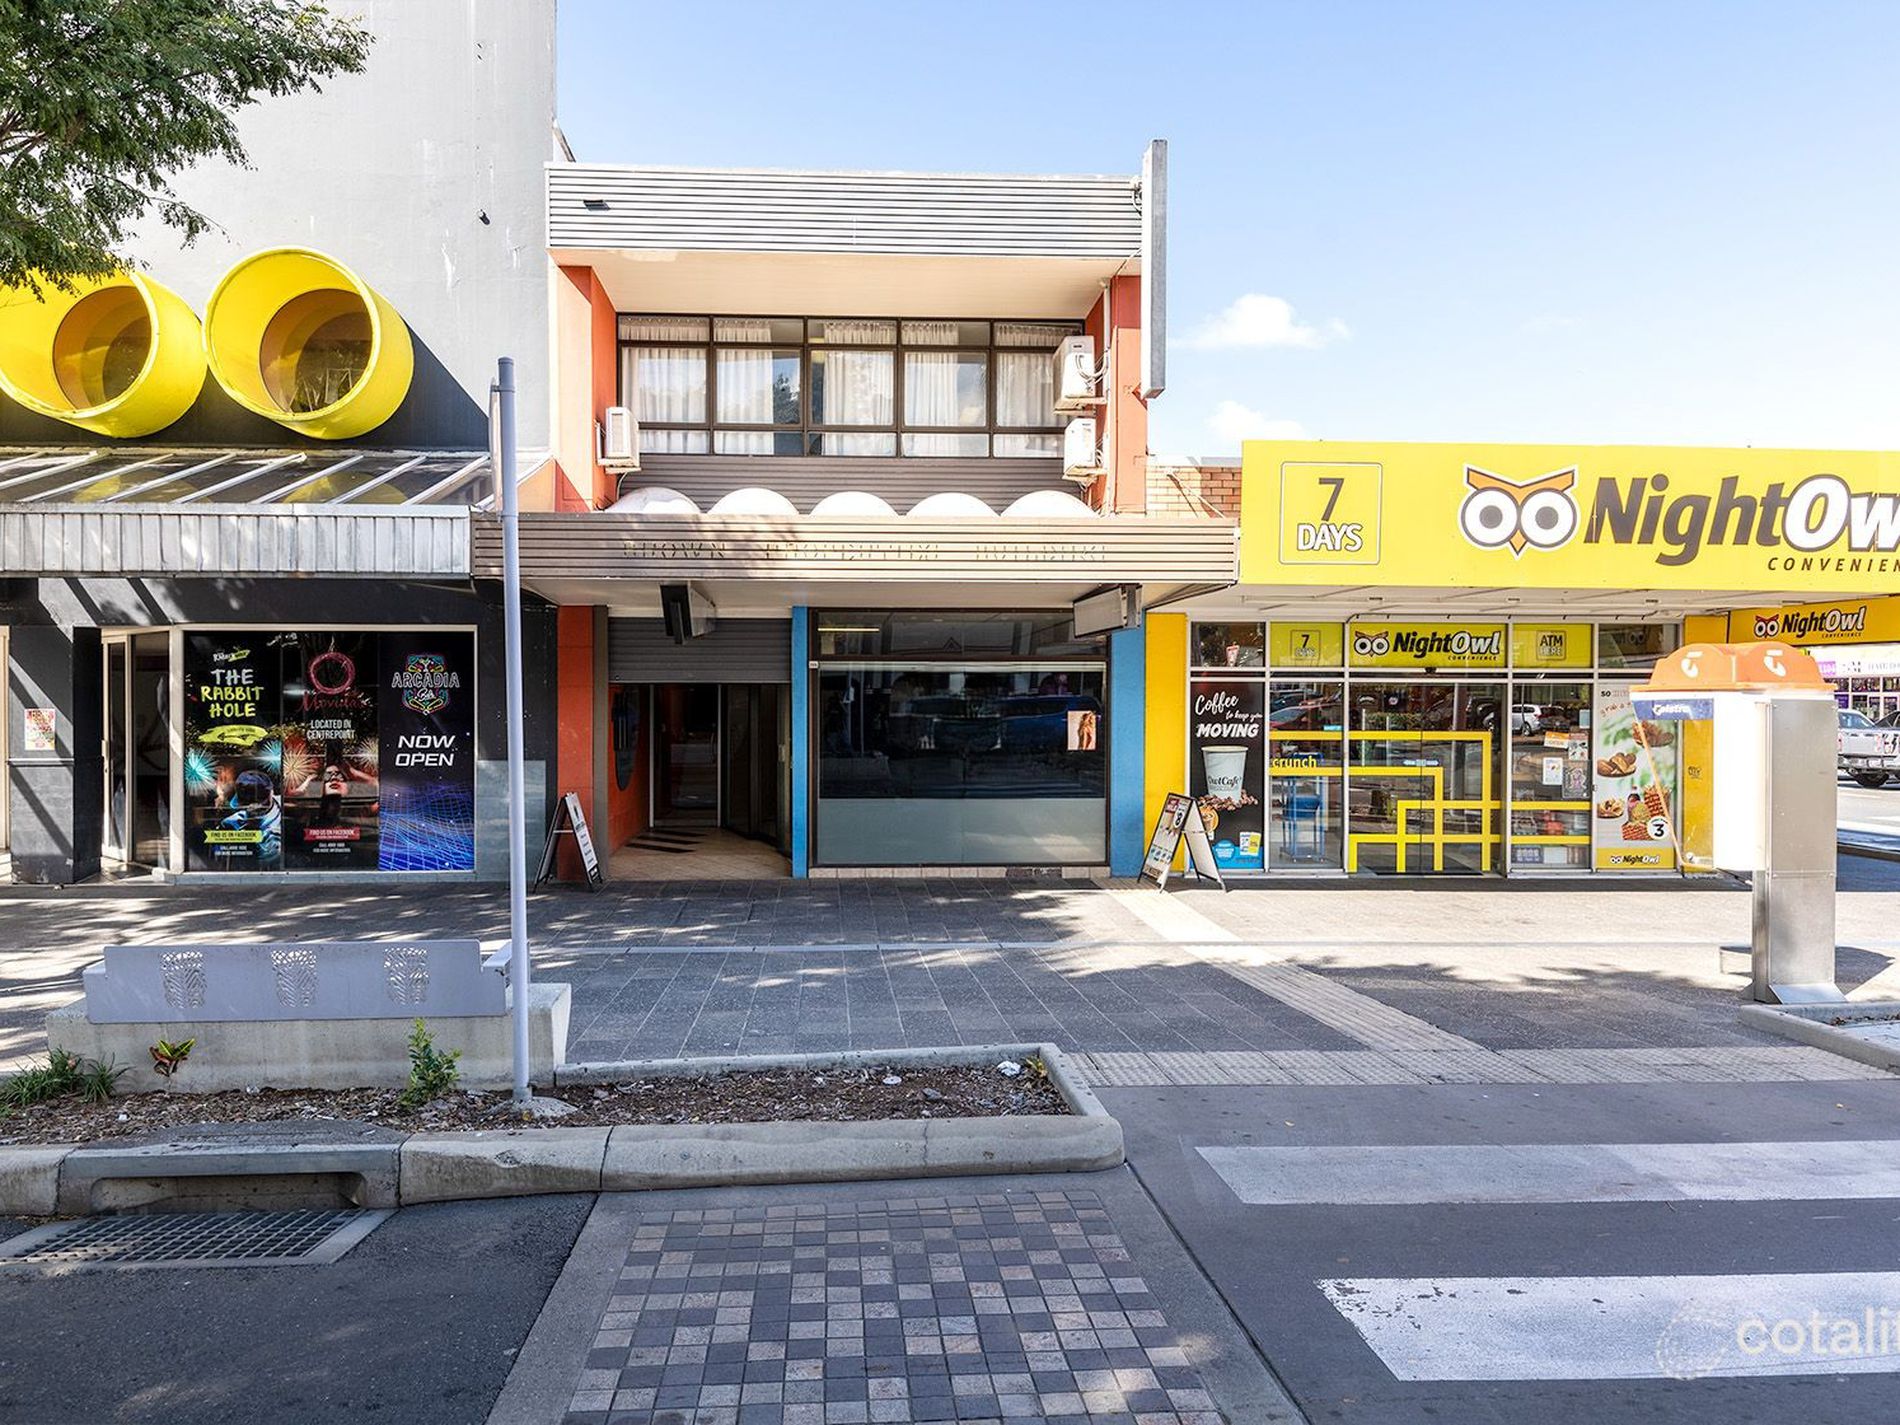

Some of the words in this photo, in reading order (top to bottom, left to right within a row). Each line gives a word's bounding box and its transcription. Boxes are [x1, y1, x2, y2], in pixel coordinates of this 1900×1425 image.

[1318, 477, 1345, 522] 7
[1297, 522, 1364, 552] DAYS
[1781, 605, 1867, 638] NightOwl
[1301, 634, 1310, 648] 7
[1392, 630, 1502, 659] NightOwl
[1540, 634, 1563, 647] ATM
[210, 669, 254, 686] THE
[391, 671, 460, 688] ARCADIA
[200, 685, 265, 702] RABBIT
[209, 702, 257, 718] HOLE
[1195, 691, 1239, 716] Coffee
[1226, 710, 1234, 720] to
[1234, 709, 1249, 722] keep
[310, 720, 342, 730] LOCATED
[343, 720, 352, 730] IN
[1196, 723, 1260, 738] MOVING
[398, 735, 456, 749] NOW
[395, 753, 455, 767] OPEN
[1272, 756, 1317, 769] crunch
[1653, 823, 1665, 837] 3
[1622, 853, 1660, 865] NightOwl
